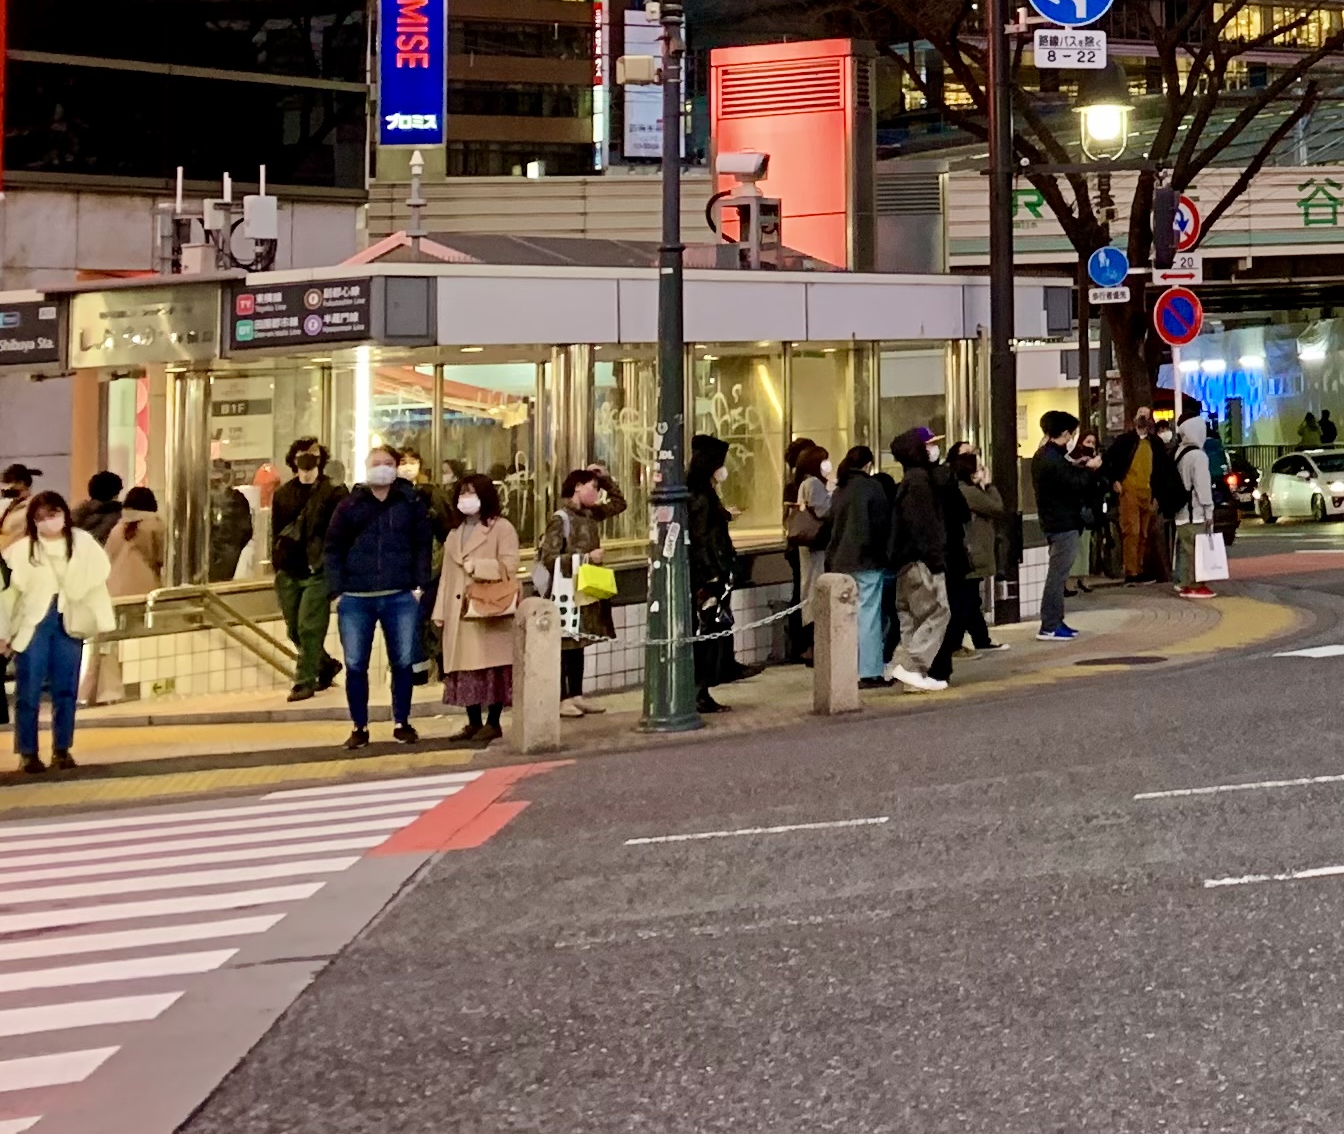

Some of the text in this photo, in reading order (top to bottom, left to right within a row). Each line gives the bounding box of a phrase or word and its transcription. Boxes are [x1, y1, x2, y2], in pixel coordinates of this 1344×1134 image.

[385, 112, 438, 130] プロミス
[0, 338, 35, 354] Shibuya
